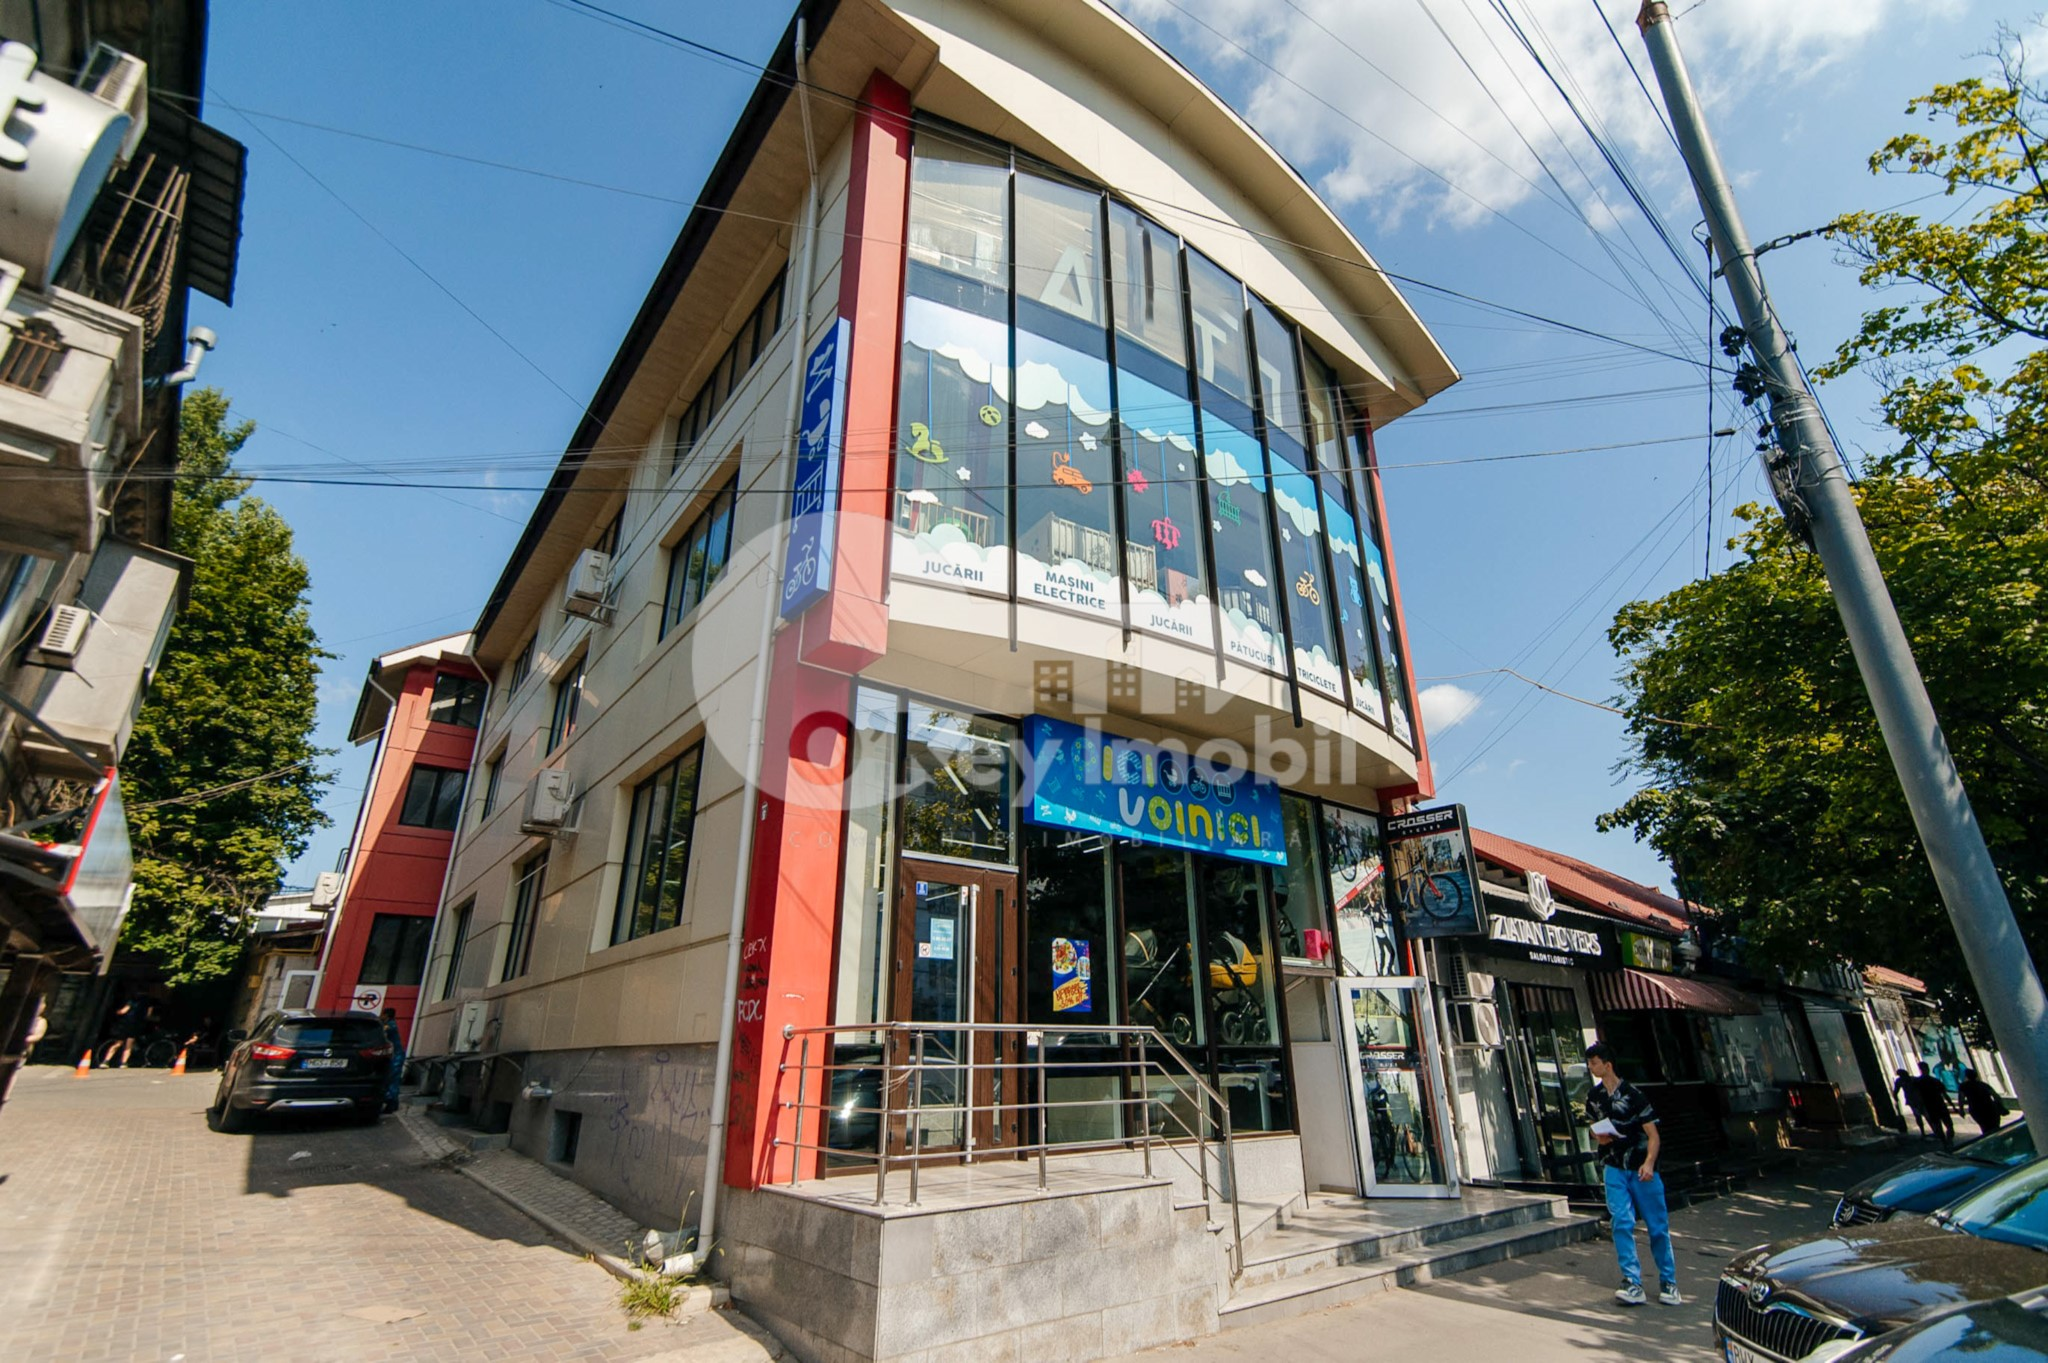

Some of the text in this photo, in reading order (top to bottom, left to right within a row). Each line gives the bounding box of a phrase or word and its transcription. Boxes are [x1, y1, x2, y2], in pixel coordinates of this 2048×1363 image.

[922, 560, 984, 582] JUCĂRII
[1034, 583, 1106, 610] ELECTRICE
[1297, 667, 1337, 693] TRICICLETE
[1387, 809, 1454, 832] CROSSER
